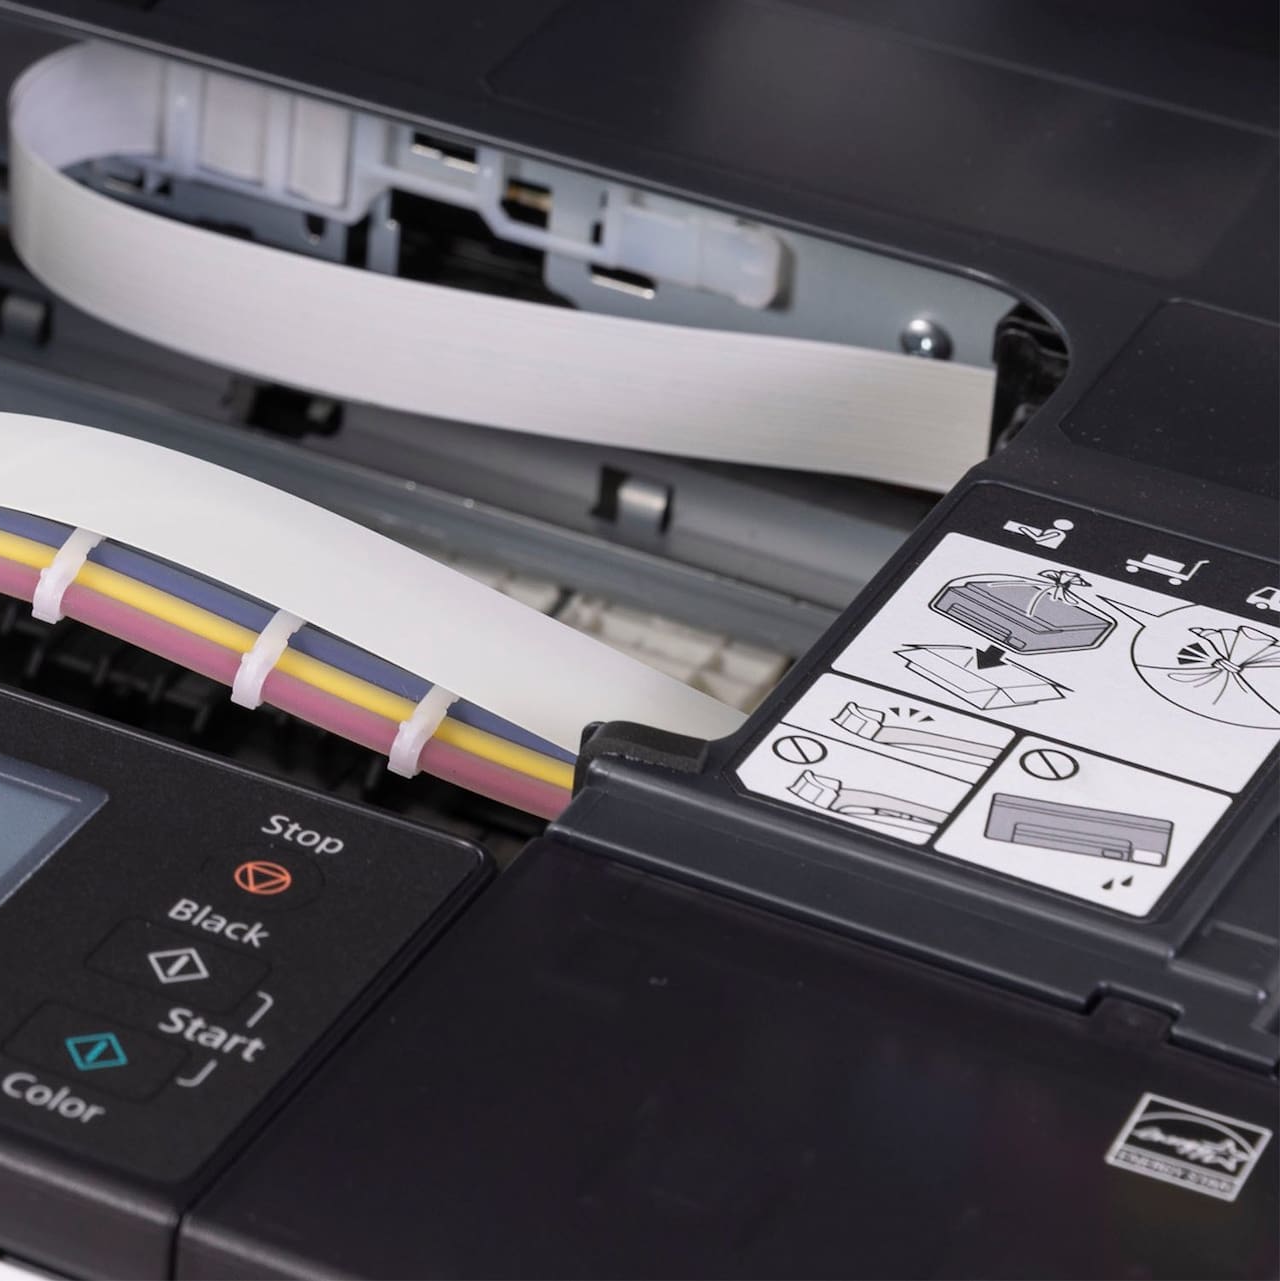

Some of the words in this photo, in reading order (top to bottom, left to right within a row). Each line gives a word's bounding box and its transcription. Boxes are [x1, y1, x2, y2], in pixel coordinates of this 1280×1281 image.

[261, 814, 344, 854] Stop
[168, 898, 269, 947] Black
[158, 1007, 266, 1062] Start
[2, 1072, 106, 1122] Color
